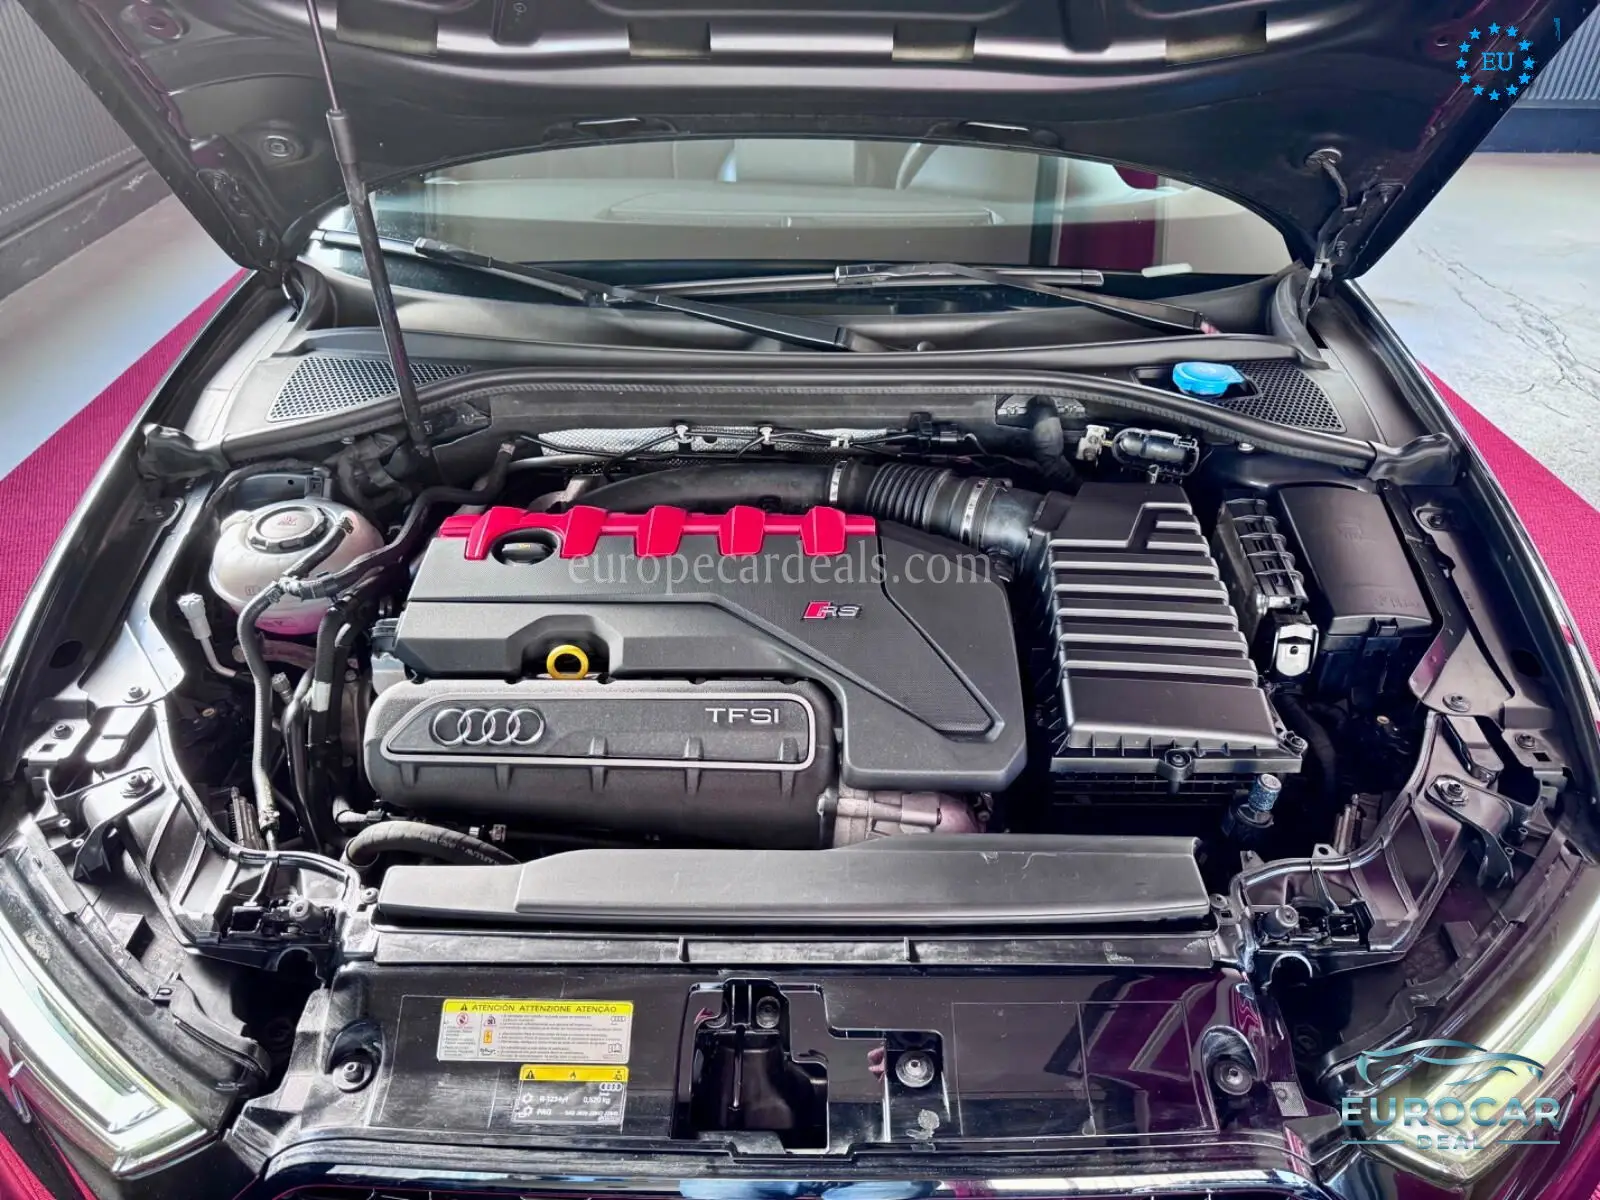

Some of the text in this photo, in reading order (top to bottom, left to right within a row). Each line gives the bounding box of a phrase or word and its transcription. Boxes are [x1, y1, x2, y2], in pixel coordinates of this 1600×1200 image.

[808, 602, 861, 618] RS
[704, 707, 781, 724] TFSI
[471, 1003, 617, 1014] ATENCIÓN ATTENZIONE ATENÇÃO
